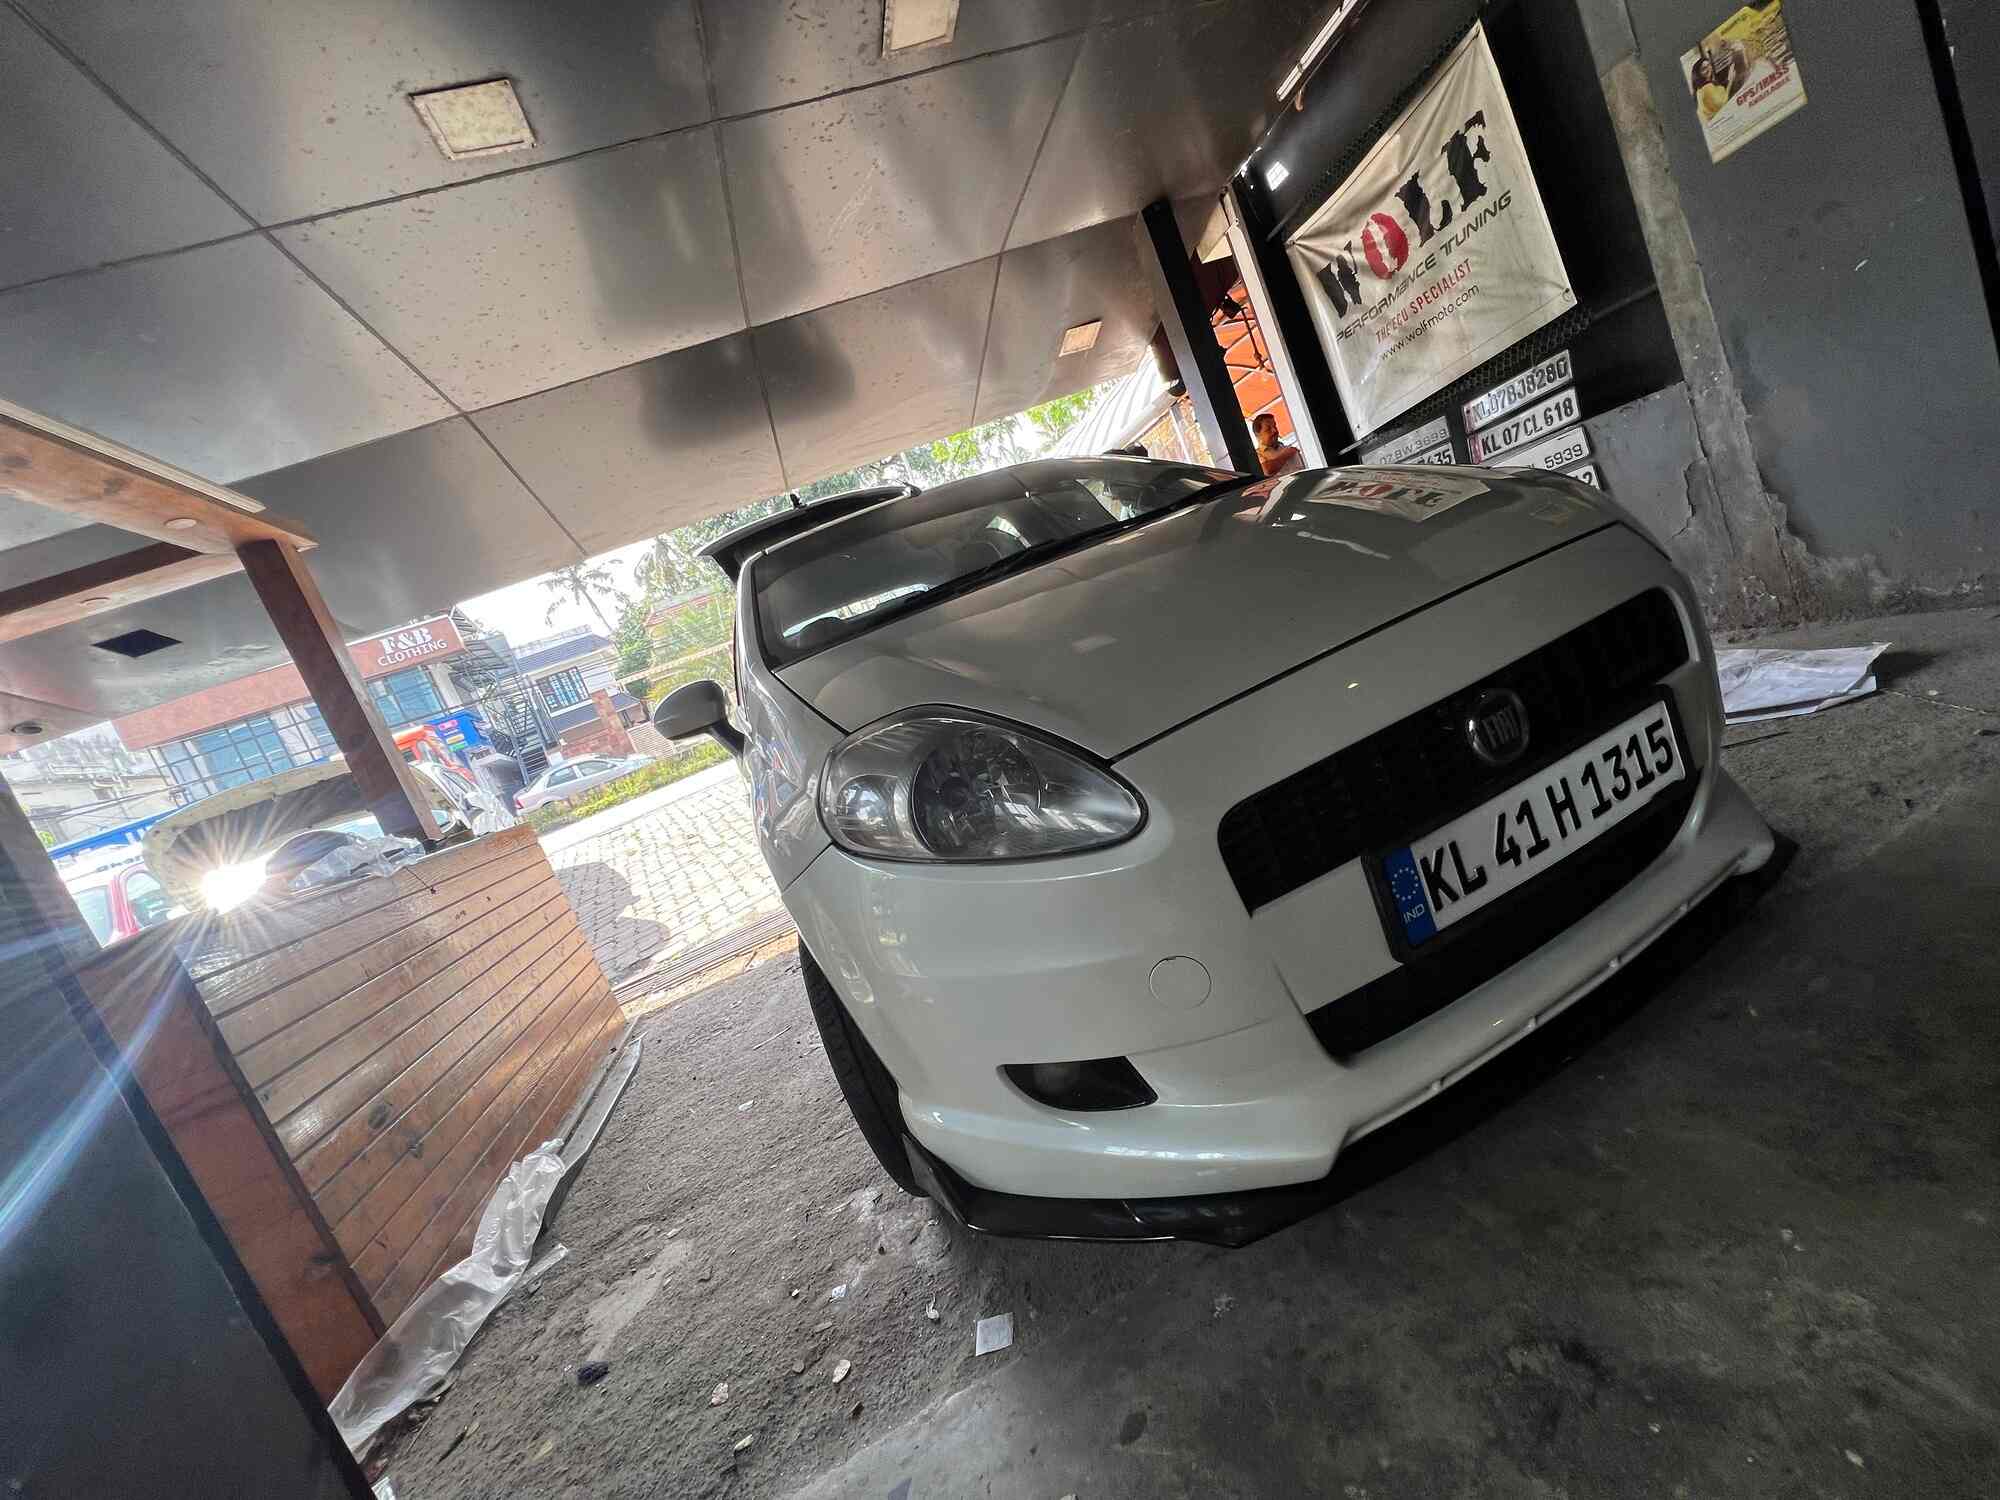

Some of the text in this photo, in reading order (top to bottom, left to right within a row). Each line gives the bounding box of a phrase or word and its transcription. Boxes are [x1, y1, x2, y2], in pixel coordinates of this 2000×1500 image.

[1317, 110, 1491, 319] WOLF
[1336, 190, 1512, 342] PERFORMANCE TUNING
[1376, 258, 1473, 344] THE ECU SPECIALIST
[1381, 284, 1480, 361] www.wolfmoto.com
[1483, 397, 1574, 457] KL 07 CL 618
[1545, 443, 1584, 469] 5939
[377, 639, 448, 667] CLOTHING
[1420, 718, 1674, 912] KL 41 H 1315
[1403, 903, 1425, 925] IND
